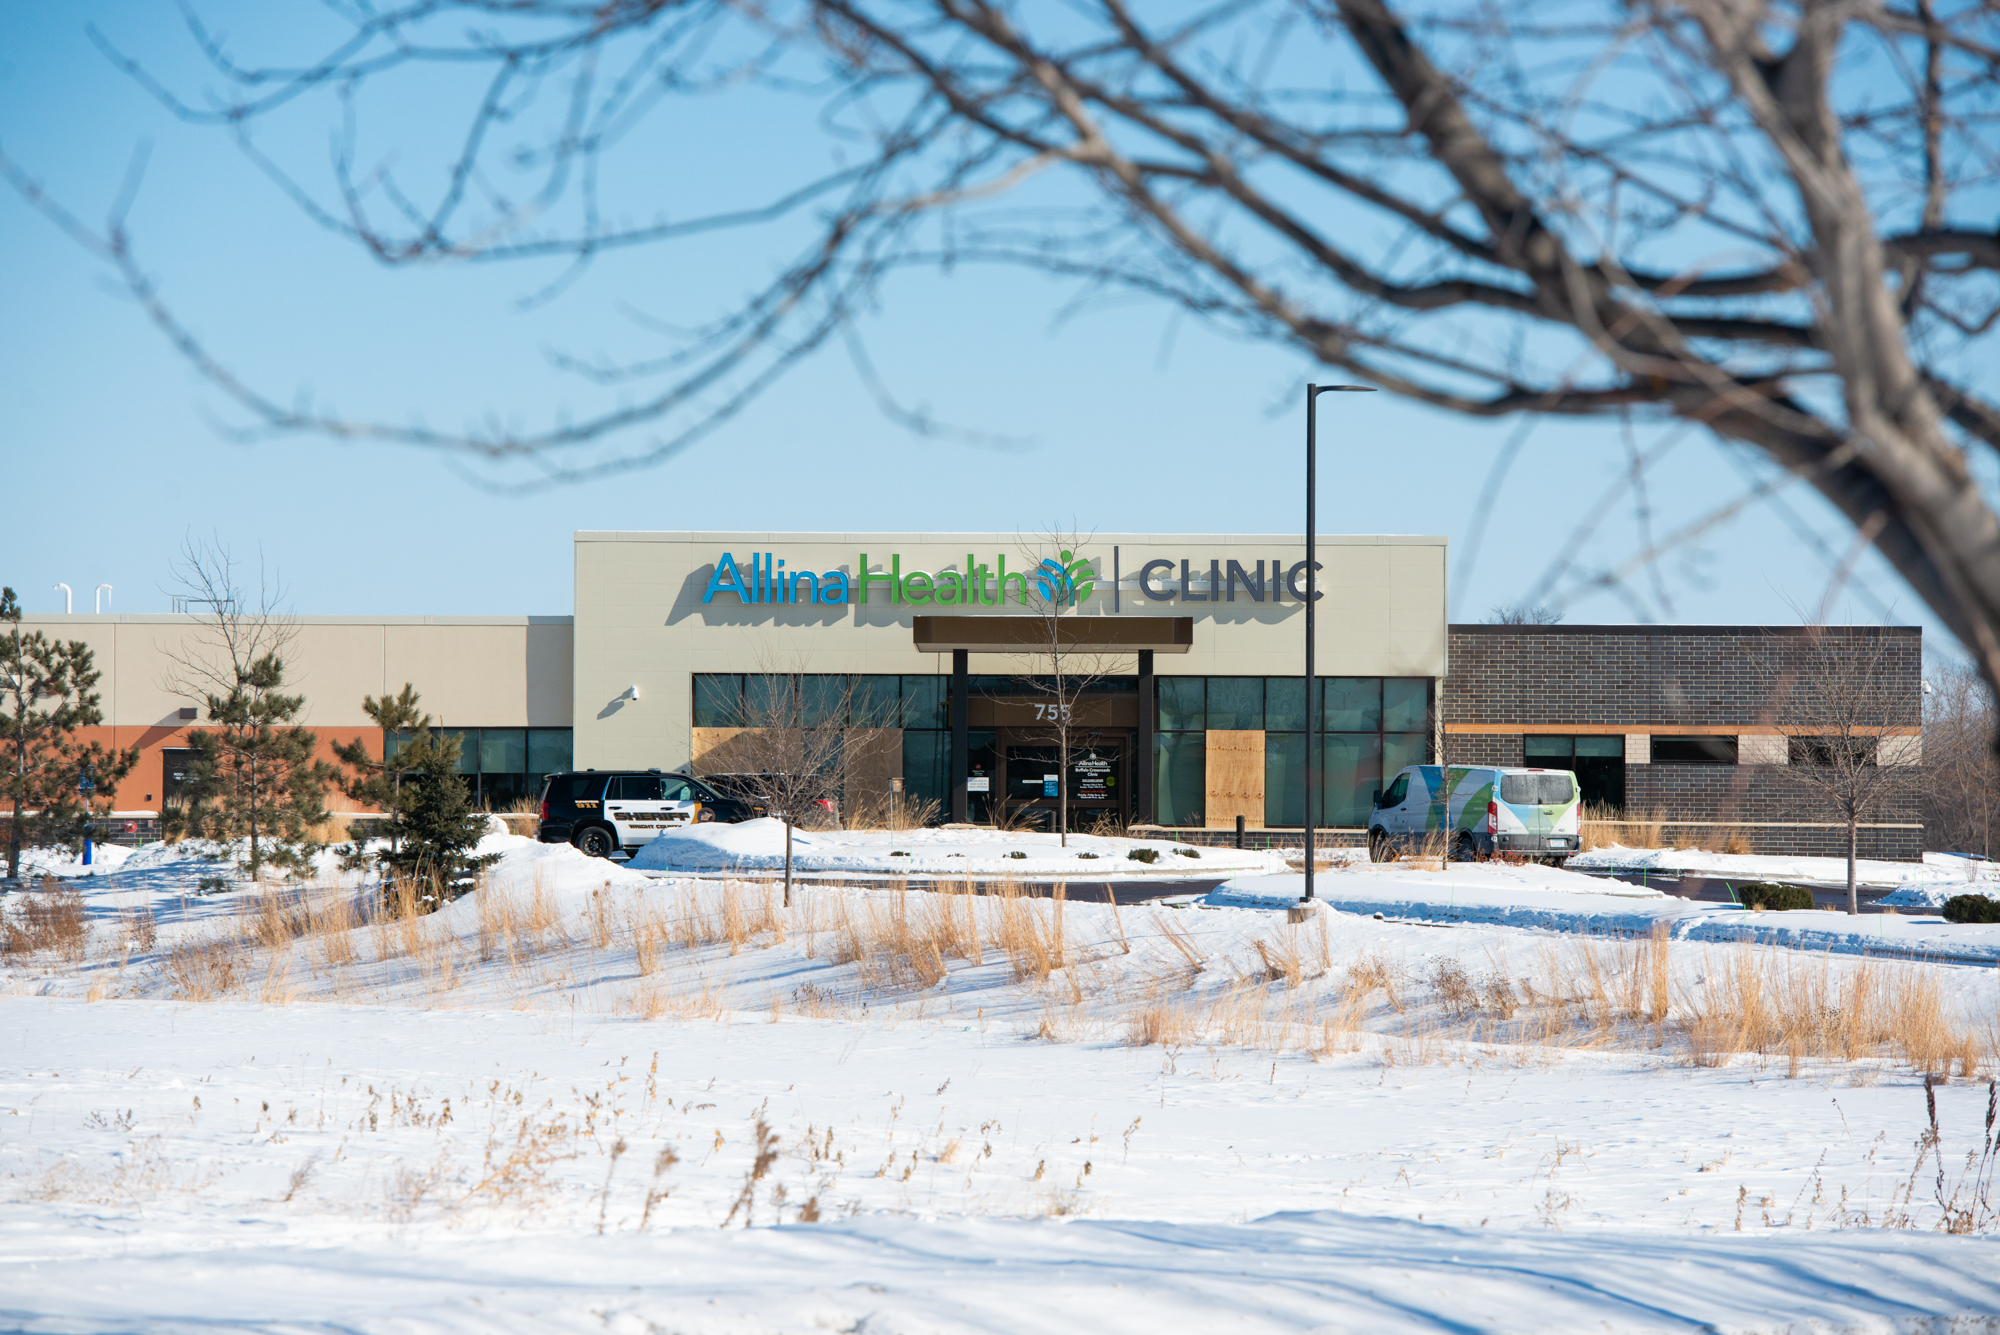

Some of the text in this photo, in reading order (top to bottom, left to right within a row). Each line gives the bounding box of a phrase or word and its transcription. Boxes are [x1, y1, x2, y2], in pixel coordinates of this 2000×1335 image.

[701, 552, 1027, 606] Allina Health
[1139, 558, 1325, 602] CLINIC
[1034, 704, 1071, 720] 755
[613, 812, 690, 821] SHERIFF
